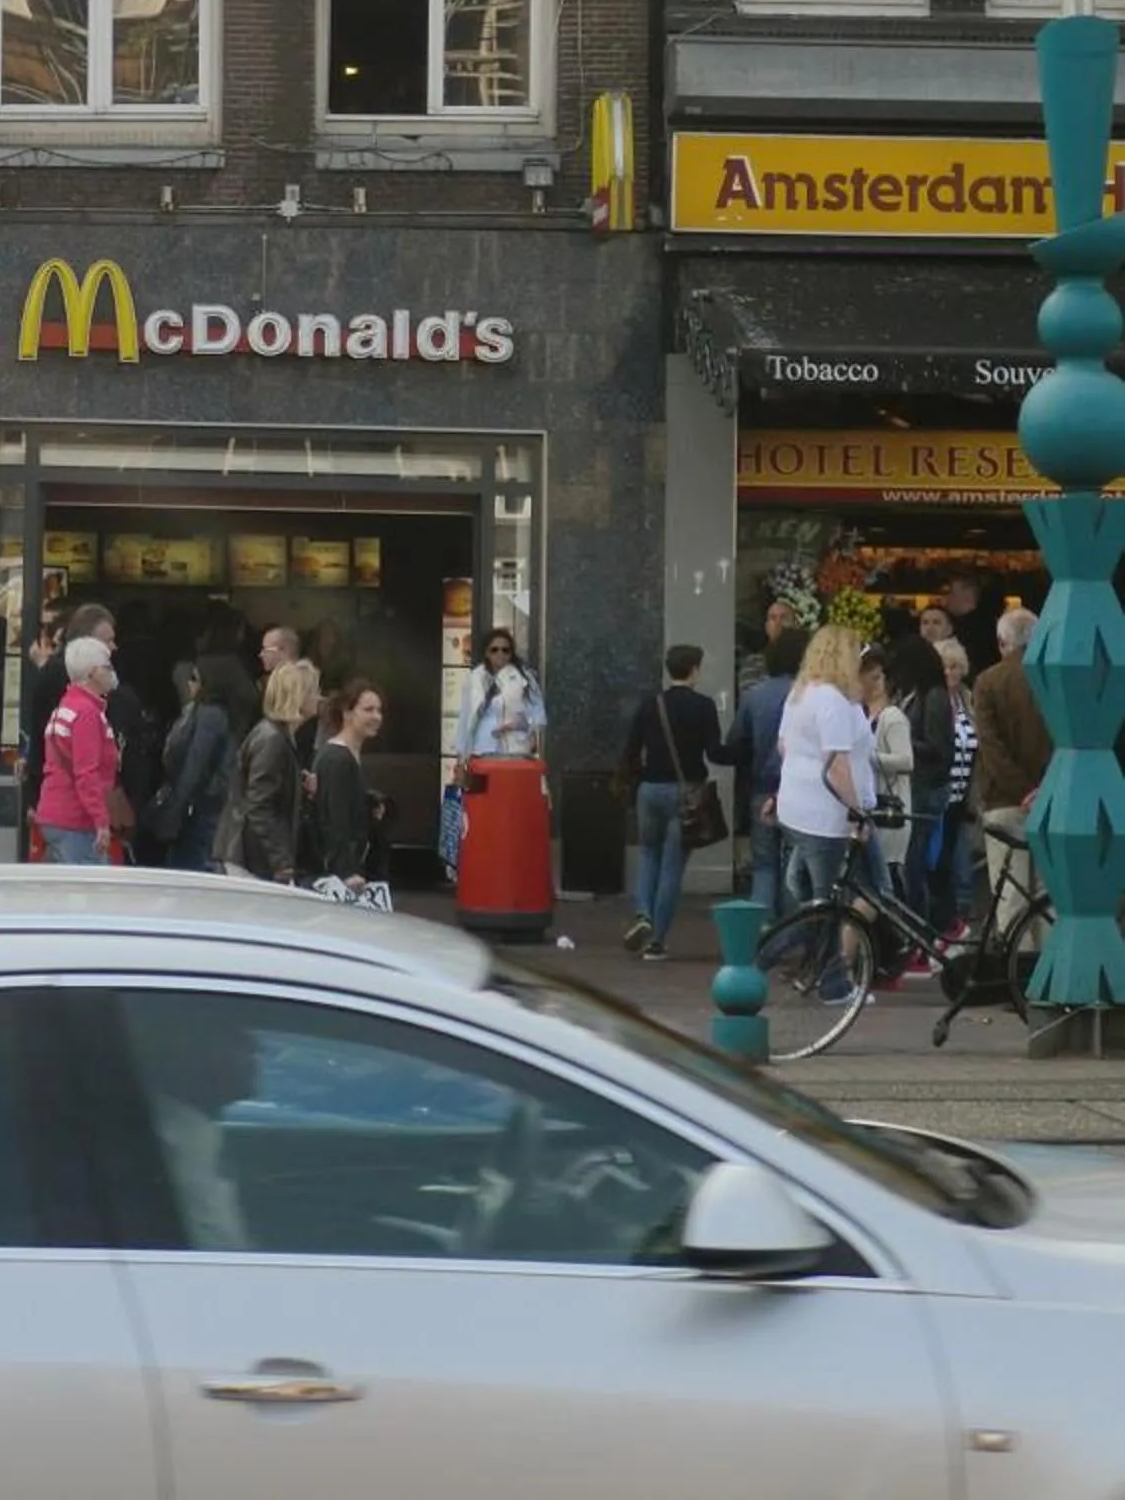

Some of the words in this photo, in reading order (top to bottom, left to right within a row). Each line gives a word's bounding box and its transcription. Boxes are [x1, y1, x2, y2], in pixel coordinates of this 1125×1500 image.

[18, 258, 514, 364] McDonald's
[767, 355, 879, 383] Tobacco
[737, 443, 893, 476] HOTEL
